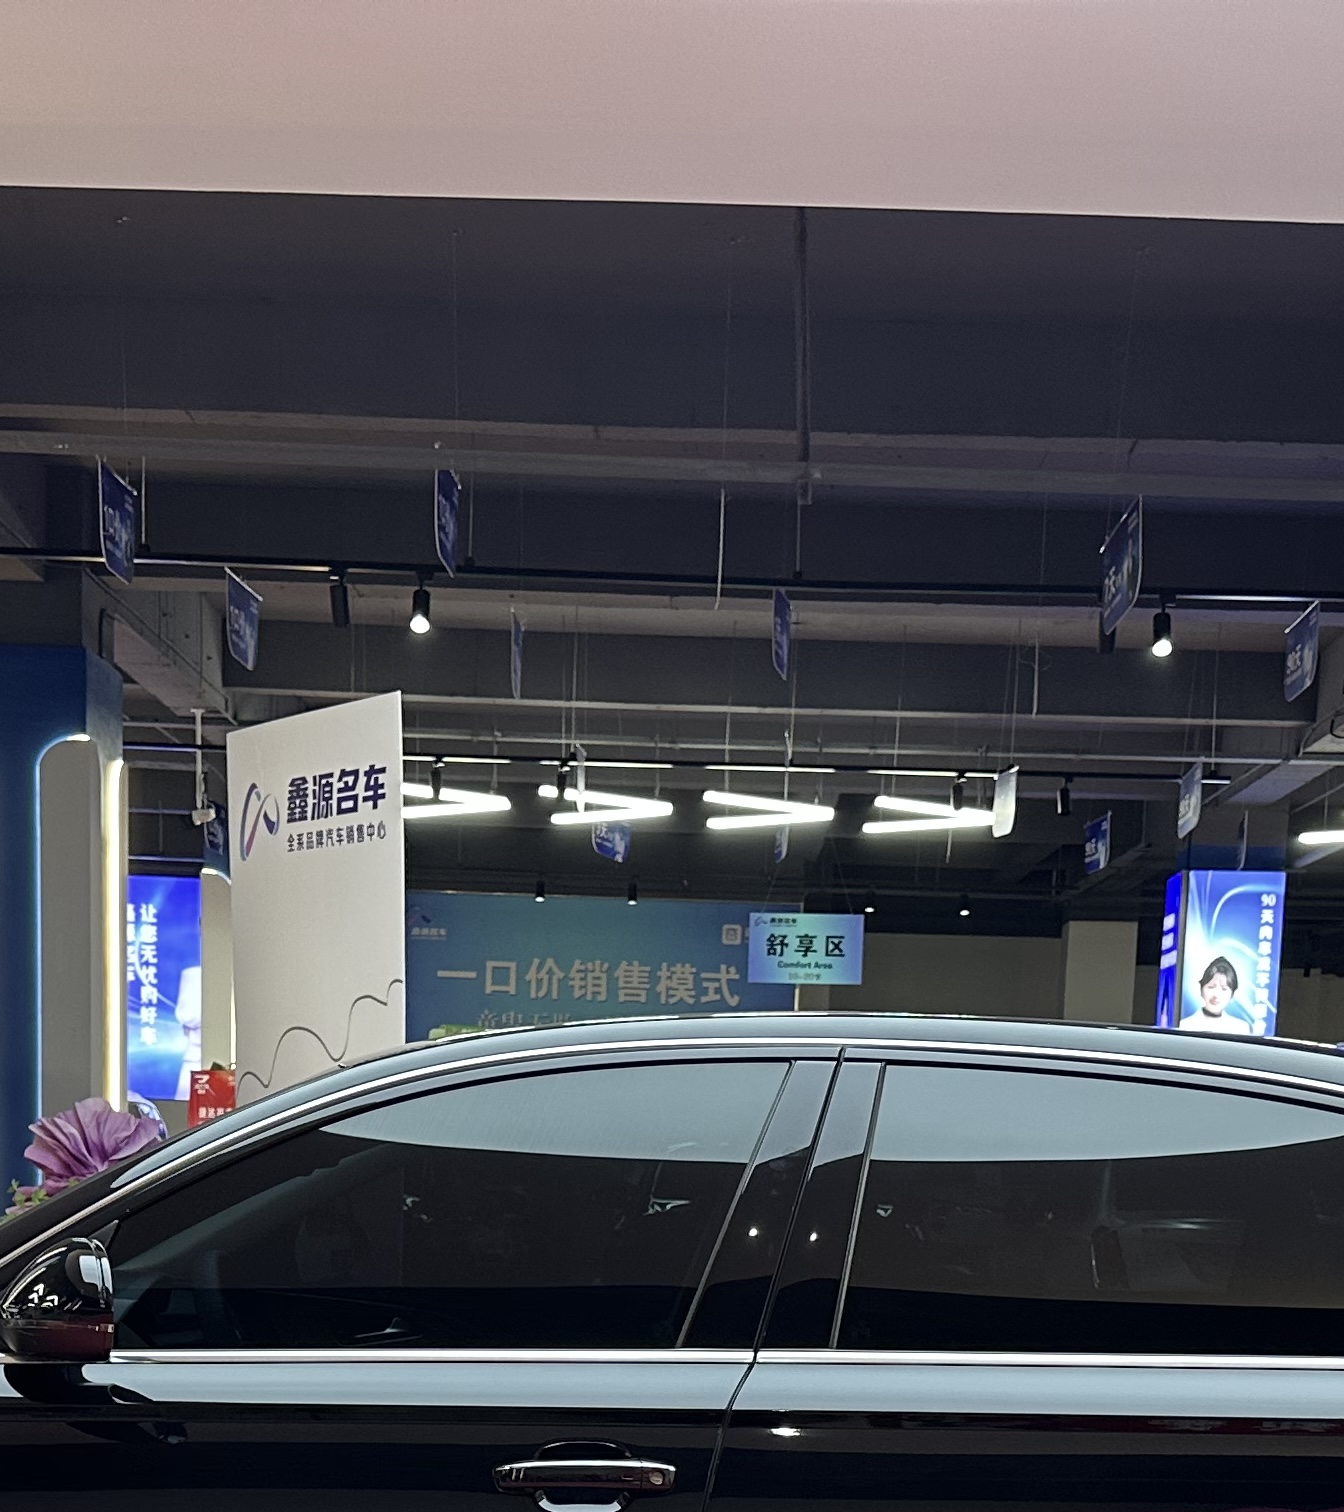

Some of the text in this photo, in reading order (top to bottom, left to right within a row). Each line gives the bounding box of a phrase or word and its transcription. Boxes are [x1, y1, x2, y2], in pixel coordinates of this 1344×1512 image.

[286, 764, 387, 824] 鑫源名车
[766, 932, 846, 958] 舒享区
[437, 956, 741, 1007] 一口价销售模式
[777, 960, 833, 970] Comfort Area
